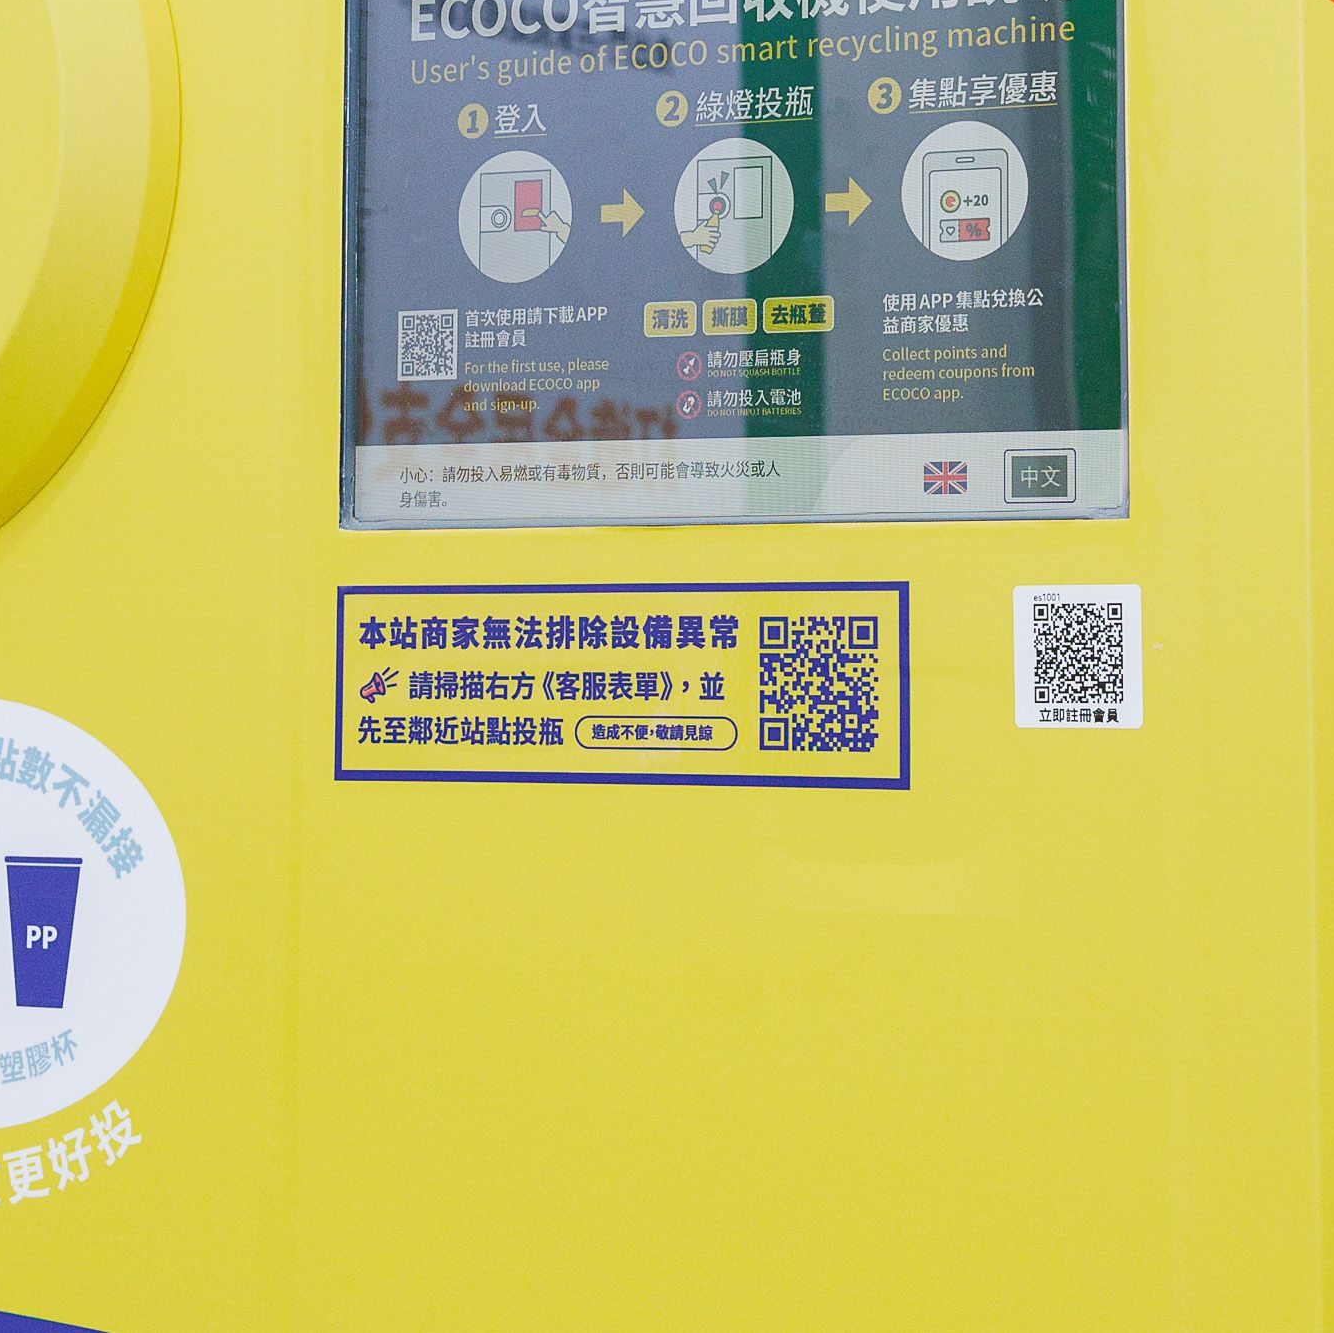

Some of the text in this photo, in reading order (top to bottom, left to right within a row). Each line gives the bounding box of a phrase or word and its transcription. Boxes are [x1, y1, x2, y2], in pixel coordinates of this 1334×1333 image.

[411, 14, 1076, 86] User's guide of ECOCO smart recycling machine
[909, 69, 1059, 110] 集點享優惠
[695, 84, 814, 122] 綠燈投瓶
[493, 103, 547, 134] 登入
[963, 193, 988, 209] +20
[652, 308, 689, 330] 清洗
[712, 305, 748, 328] 撕膜
[771, 303, 827, 325] 去瓶蓋
[882, 314, 969, 334] 益商家優惠
[464, 329, 527, 349] 註冊會員
[707, 348, 801, 368] 請勿壓扁瓶身
[882, 344, 1008, 363] Collect points and
[464, 357, 610, 377] For the first use, please
[738, 368, 770, 378] SQUASH
[772, 367, 801, 376] BOTTLE
[883, 363, 1035, 381] redeem coupons from
[464, 377, 601, 395] download ECOCO app
[883, 387, 964, 402] ECOCO app.
[464, 397, 540, 414] and sign-up.
[707, 388, 802, 408] 請勿投入電池
[762, 407, 802, 416] BATTERIES
[1020, 466, 1061, 489] 中文
[399, 490, 449, 509] 身傷害。
[1033, 592, 1061, 602] es1001
[358, 614, 740, 650] 本站商家無法排除設備異常
[1039, 708, 1119, 723] 立即註冊會員
[358, 715, 564, 746] 先至鄰近站點投瓶
[25, 925, 59, 951] PP
